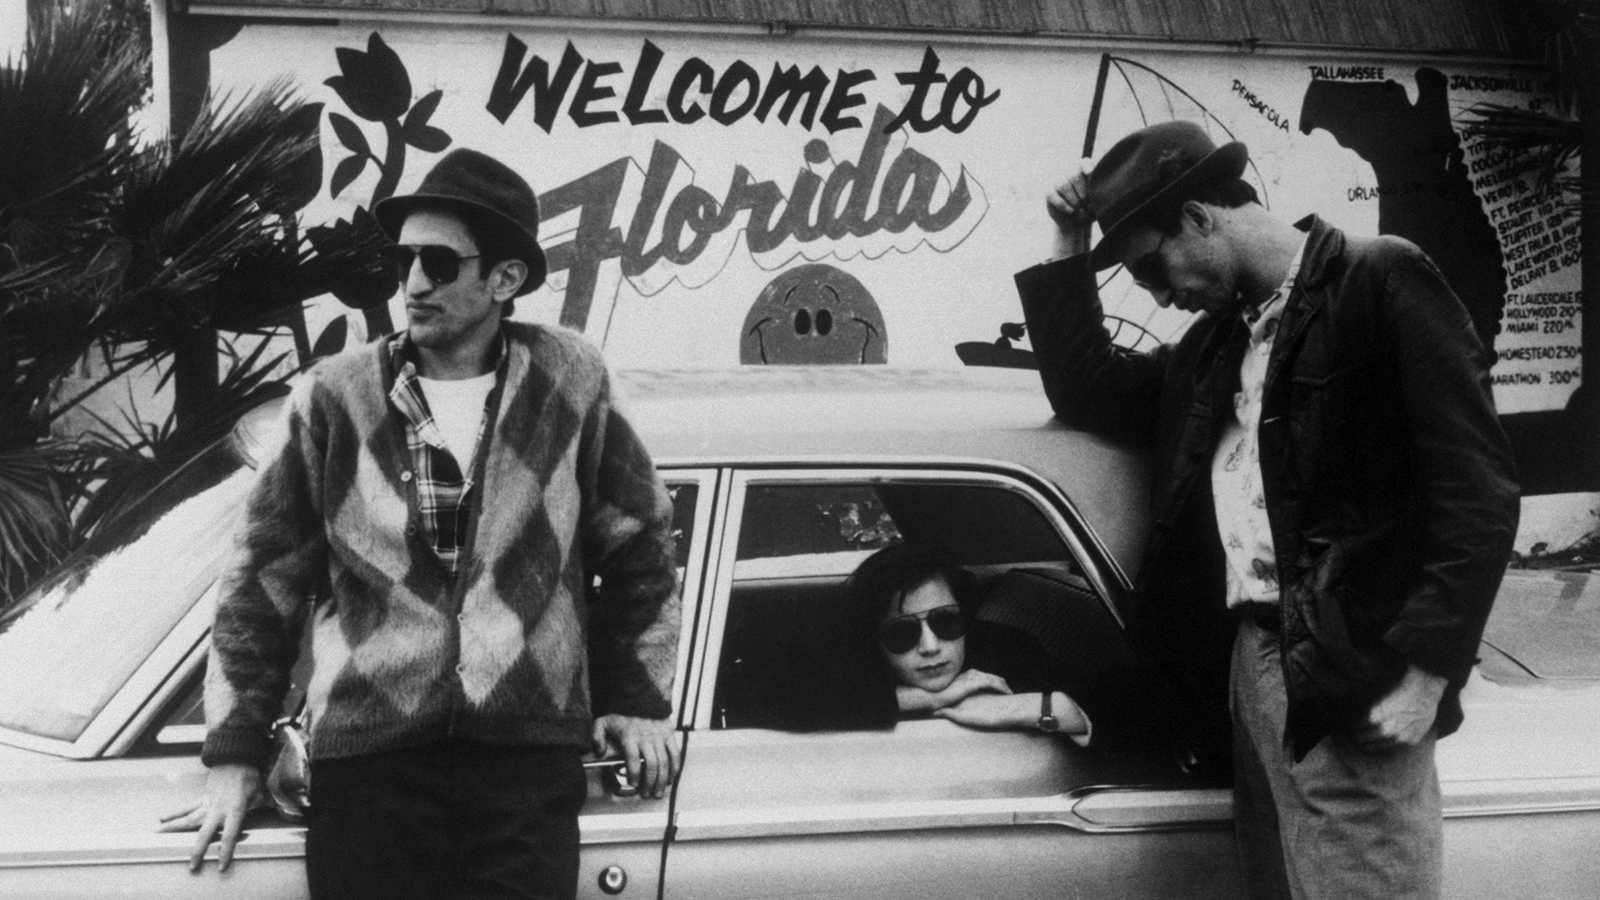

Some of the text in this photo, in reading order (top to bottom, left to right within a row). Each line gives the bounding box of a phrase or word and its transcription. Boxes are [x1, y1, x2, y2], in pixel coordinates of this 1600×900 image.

[1308, 65, 1385, 80] TALLAHASSEE
[486, 32, 1000, 135] WELCOME to
[538, 102, 974, 333] Florida
[1501, 221, 1545, 248] JUPITER
[1510, 264, 1547, 290] DELRAY
[1506, 306, 1558, 320] HOLLYWOOD
[1506, 321, 1539, 334] MIAMI
[1498, 346, 1555, 361] HOMESTEAD
